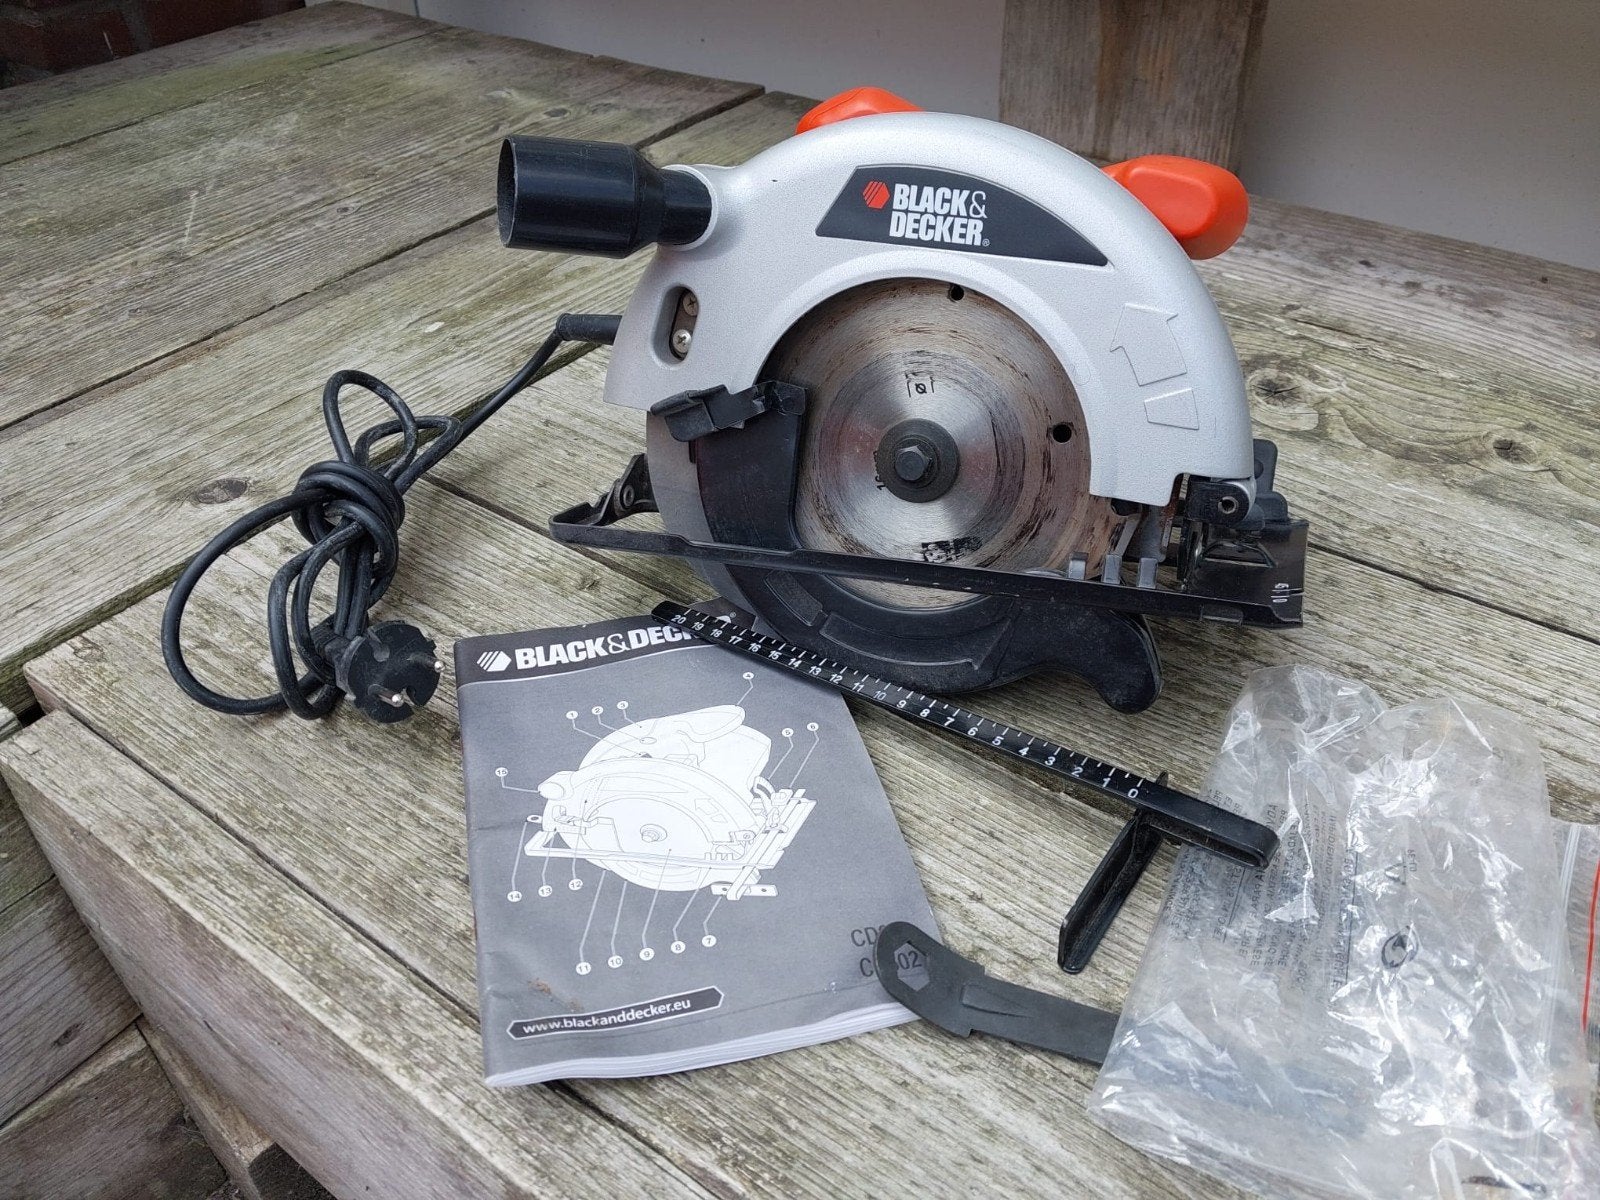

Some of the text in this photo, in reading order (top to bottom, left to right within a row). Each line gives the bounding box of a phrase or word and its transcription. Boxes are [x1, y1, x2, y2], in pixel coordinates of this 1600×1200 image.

[888, 211, 984, 247] DECKER
[671, 614, 1139, 799] 20 19 18 17 16 15 14 13 12 11 10 9 8 7 6 5 4 3 2 1 0
[522, 999, 692, 1034] www.blackanddecker.eu
